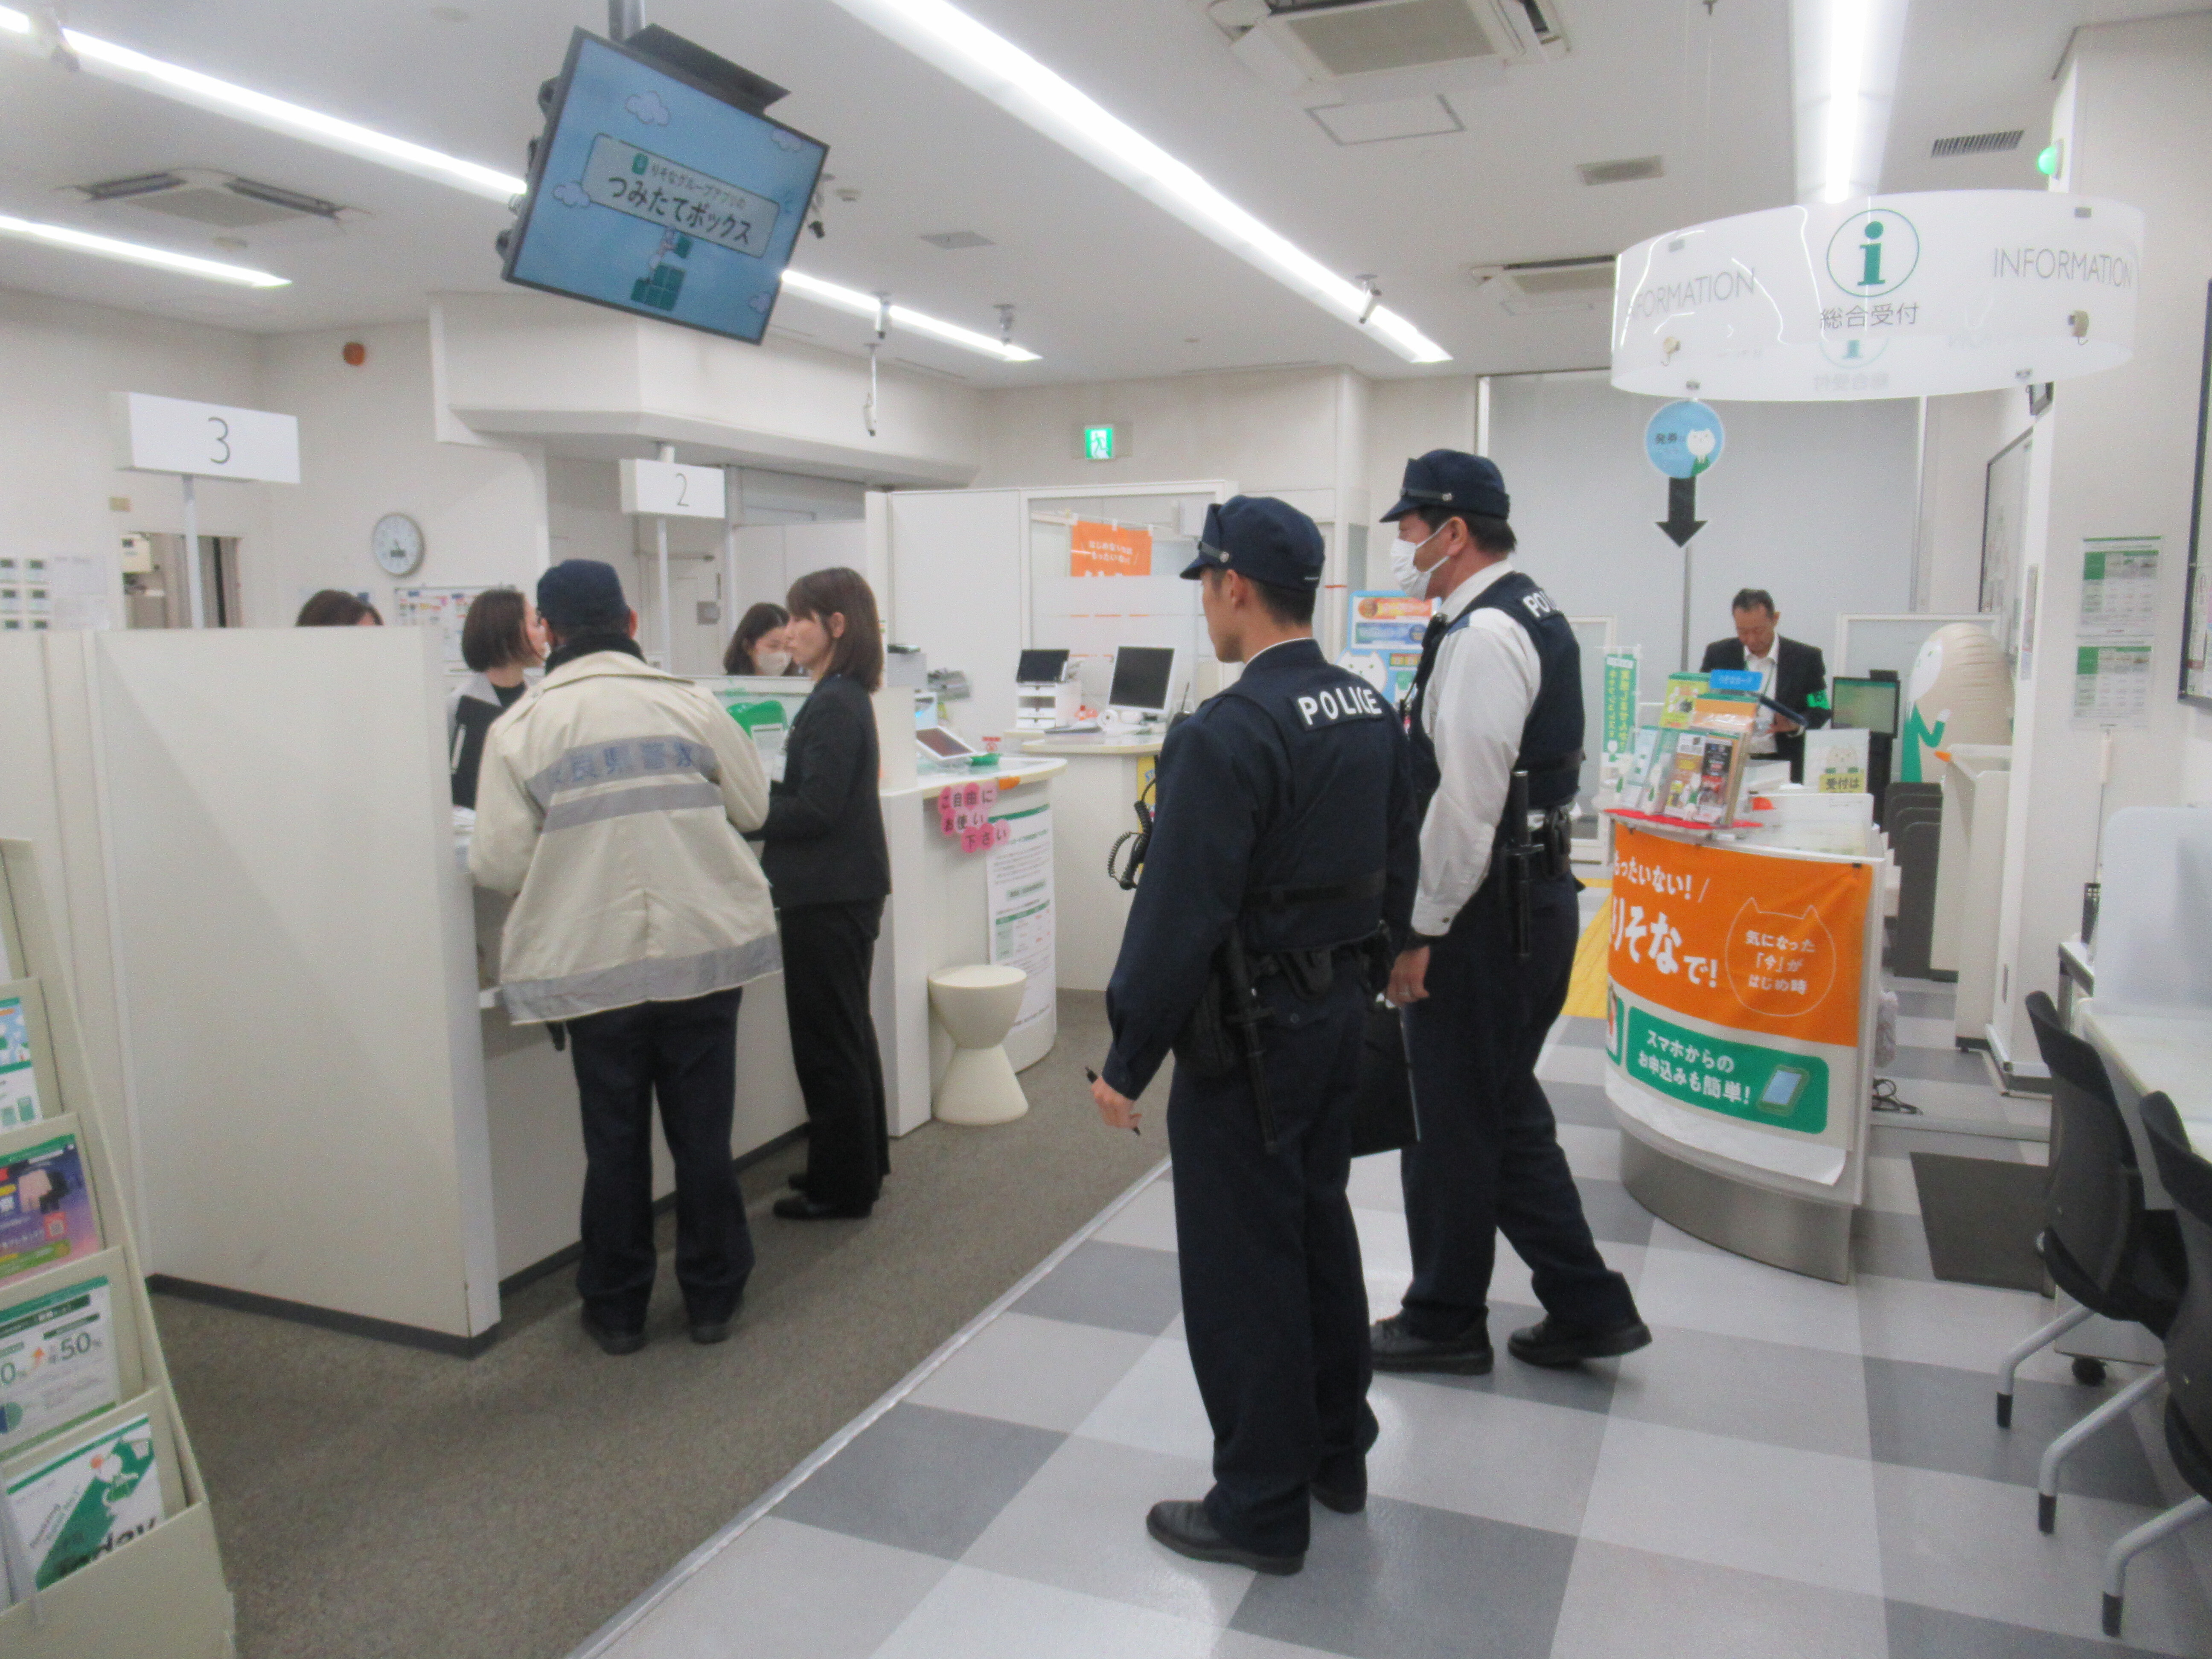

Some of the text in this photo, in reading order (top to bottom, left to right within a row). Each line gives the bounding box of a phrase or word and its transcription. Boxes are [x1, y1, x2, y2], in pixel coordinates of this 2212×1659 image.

[608, 176, 751, 244] つみたてボックス
[1993, 247, 2133, 288] INFORMATION
[1819, 301, 1920, 330] 総合受付
[208, 416, 231, 464] 3
[675, 472, 690, 507] 2
[965, 828, 1007, 849] 下さい
[1745, 930, 1816, 952] 気になった
[1748, 974, 1807, 995] はじめ時
[1647, 1029, 1735, 1073] スマホからの
[1638, 1049, 1751, 1105] お申込みも簡単!
